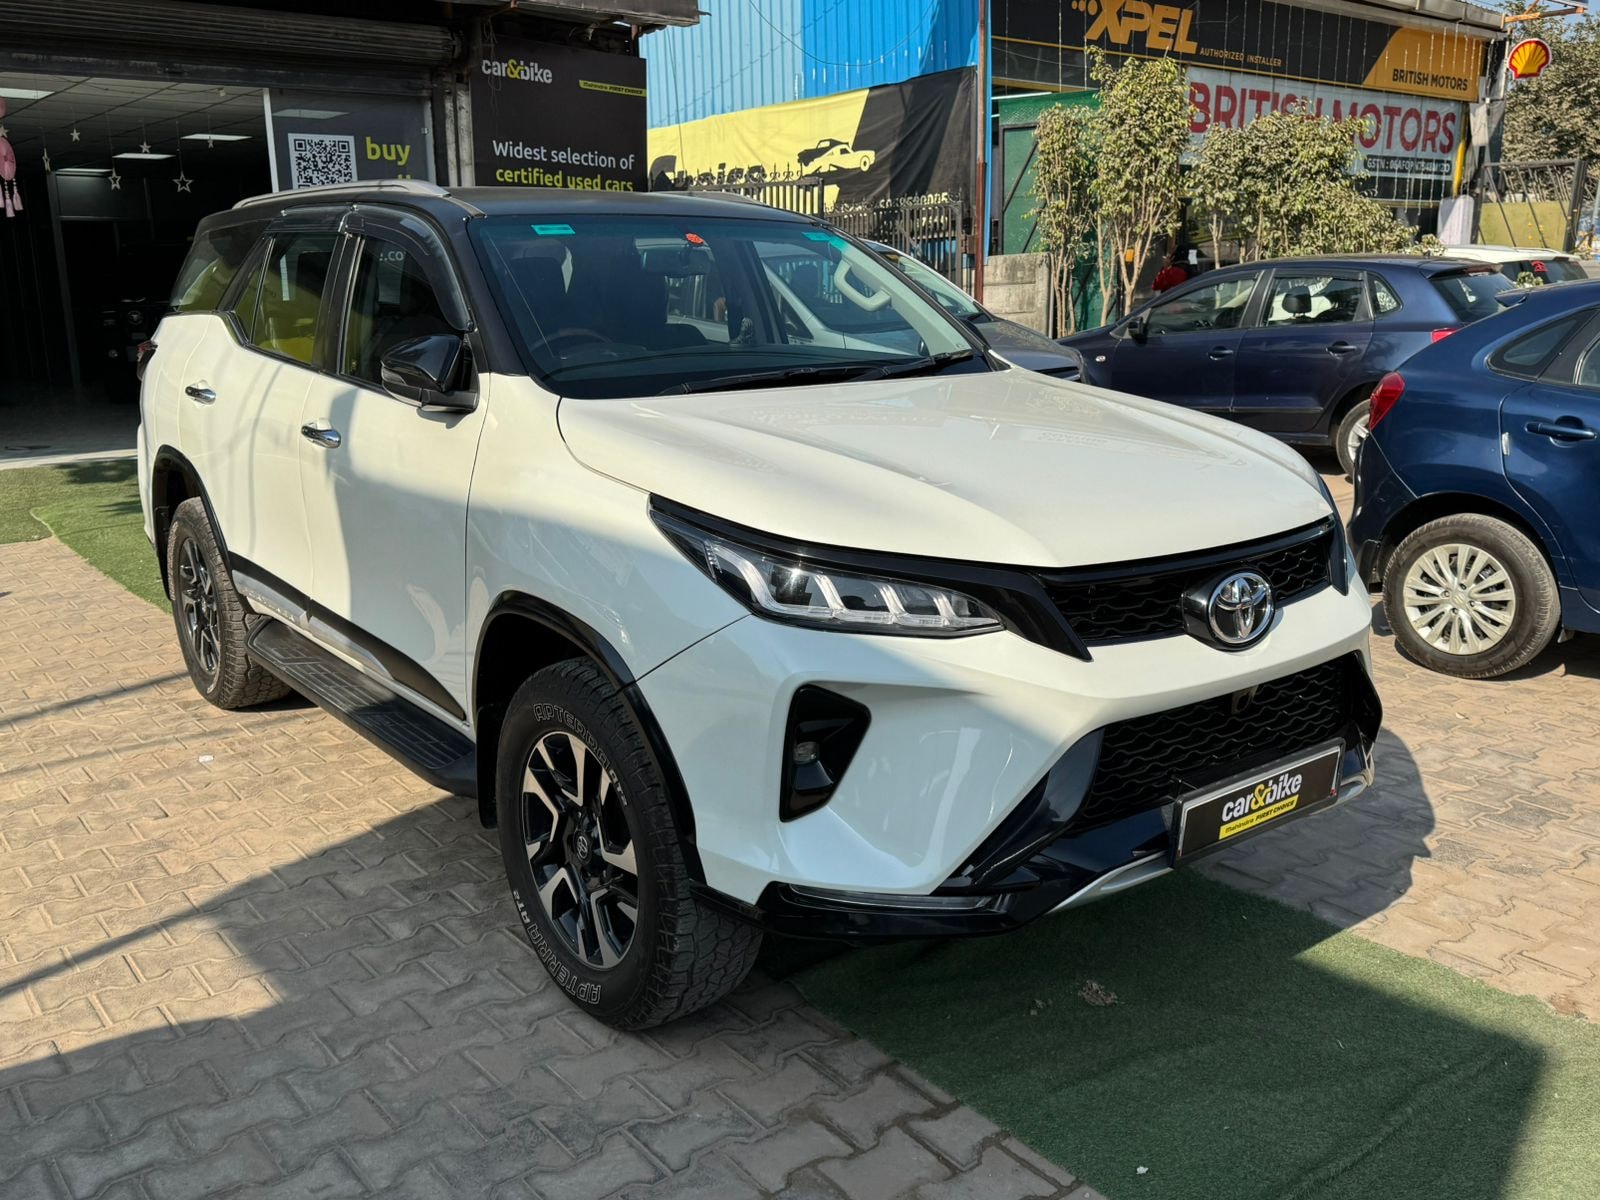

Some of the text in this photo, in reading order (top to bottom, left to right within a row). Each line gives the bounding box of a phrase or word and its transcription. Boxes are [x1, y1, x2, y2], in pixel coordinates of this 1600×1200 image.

[1085, 0, 1198, 54] XPEL
[1200, 47, 1282, 68] AUTHORIZED INSTALLER
[481, 59, 553, 84] car&bike
[1392, 68, 1469, 91] BRITISH MOTORS
[366, 136, 411, 166] buy
[493, 140, 635, 170] Widest selection of
[496, 168, 633, 192] certified used cars
[1222, 773, 1302, 822] car&bike
[1255, 809, 1273, 821] FIRST
[527, 923, 601, 1005] APTERRA
